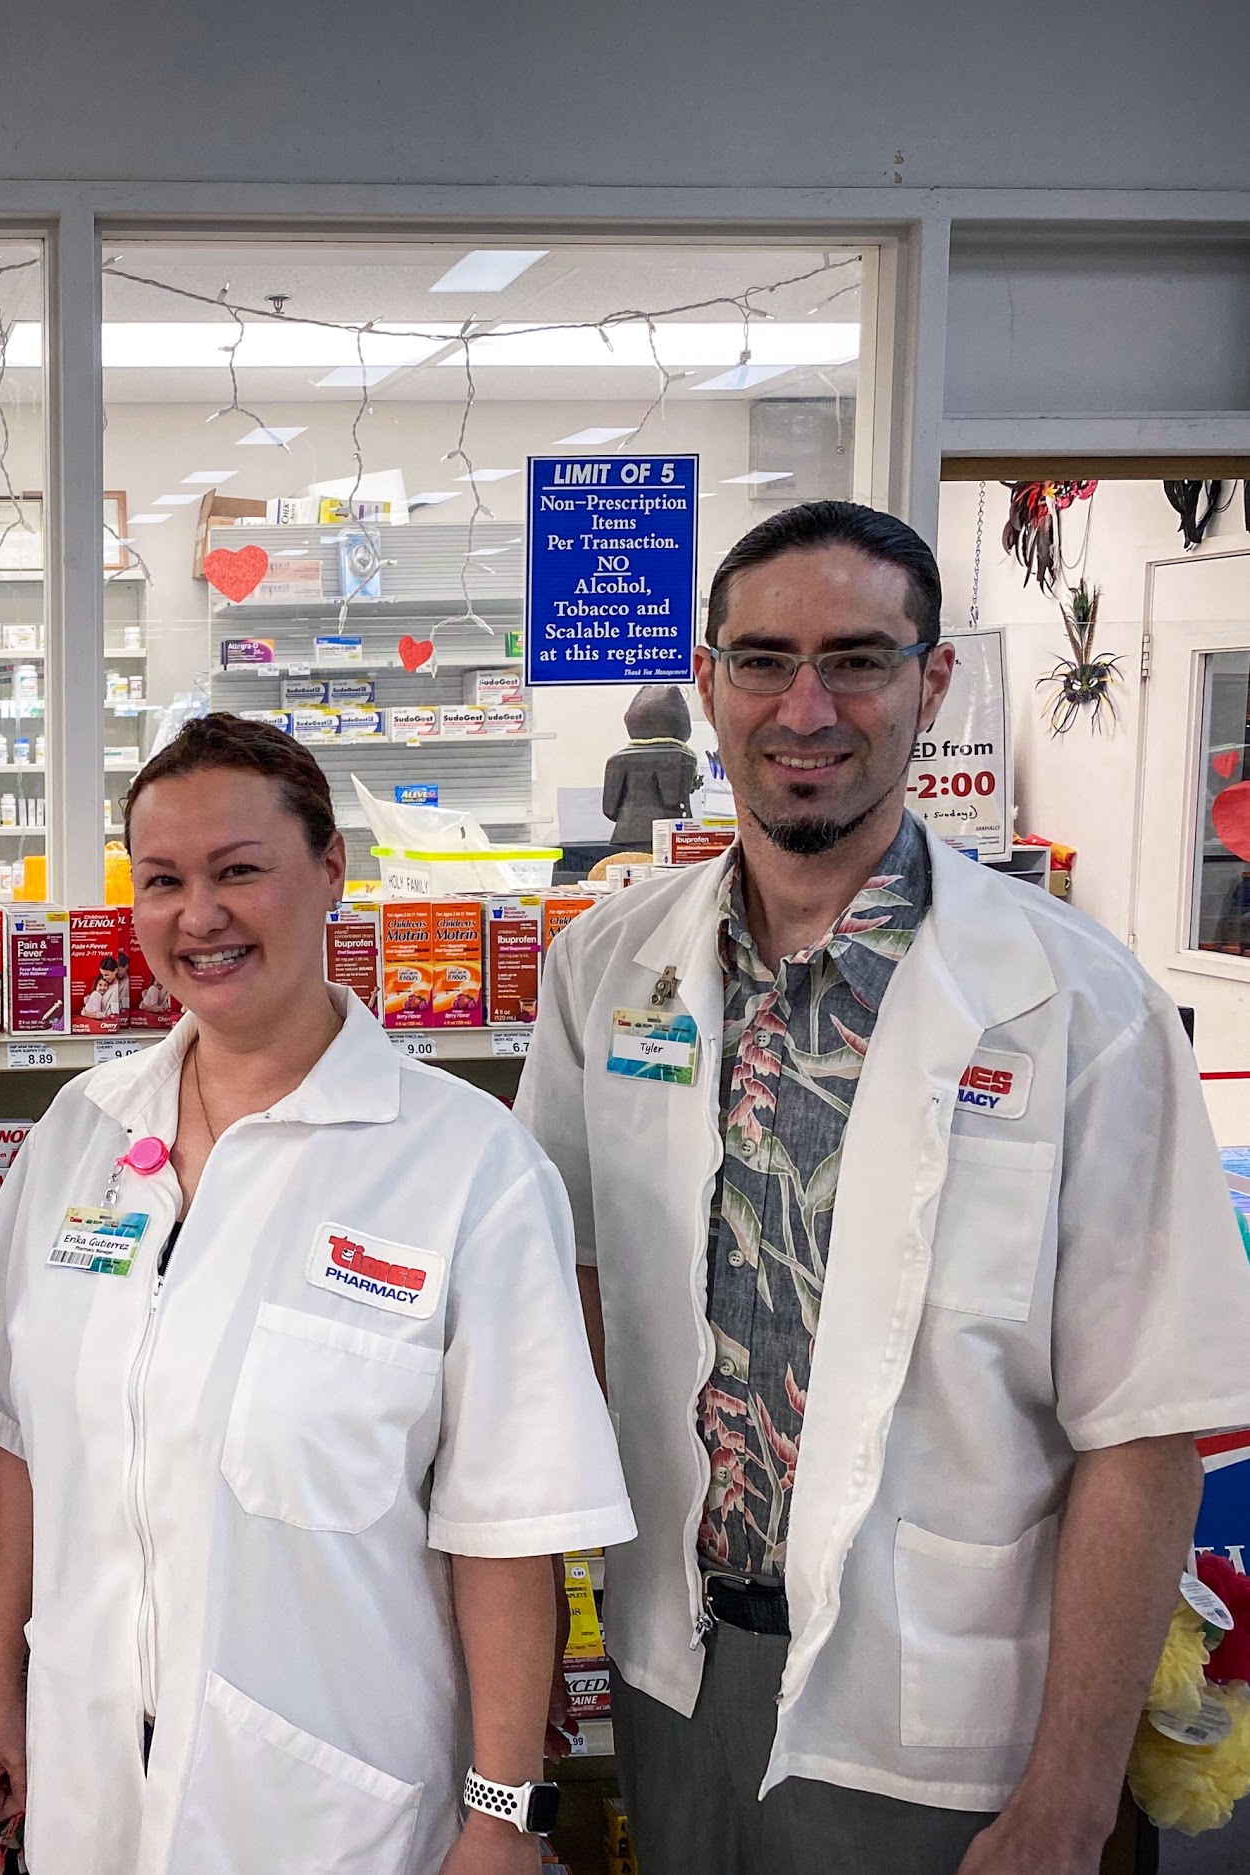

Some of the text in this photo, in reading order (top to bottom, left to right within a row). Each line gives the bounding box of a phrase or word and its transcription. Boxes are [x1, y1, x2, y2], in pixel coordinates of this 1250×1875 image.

[554, 463, 674, 484] LIMIT OF 5
[540, 494, 687, 514] Non-Prescription
[591, 515, 637, 530] Items
[547, 533, 679, 550] Per Transaction.
[596, 556, 630, 571] NO
[574, 577, 652, 596] Alcohol,
[554, 599, 670, 616] Tobacco and
[545, 622, 678, 639] Scalable Items
[540, 645, 682, 665] at this register.
[624, 668, 641, 676] Thank
[654, 668, 688, 677] Management
[942, 741, 993, 757] from
[675, 836, 709, 845] Ibuprofen
[71, 918, 115, 929] TYLENOL
[386, 929, 430, 942] Motrin
[434, 928, 479, 942] Motrin
[497, 936, 537, 945] Ibuprofen
[17, 940, 47, 949] Pain &
[334, 939, 373, 949] Ibuprofen
[18, 949, 43, 957] Fever
[407, 1044, 432, 1054] 9.00
[640, 1042, 663, 1055] Tyler
[28, 1054, 53, 1064] 8.89
[63, 1235, 130, 1250] Erika Gutierrez
[325, 1267, 419, 1304] PHARMACY
